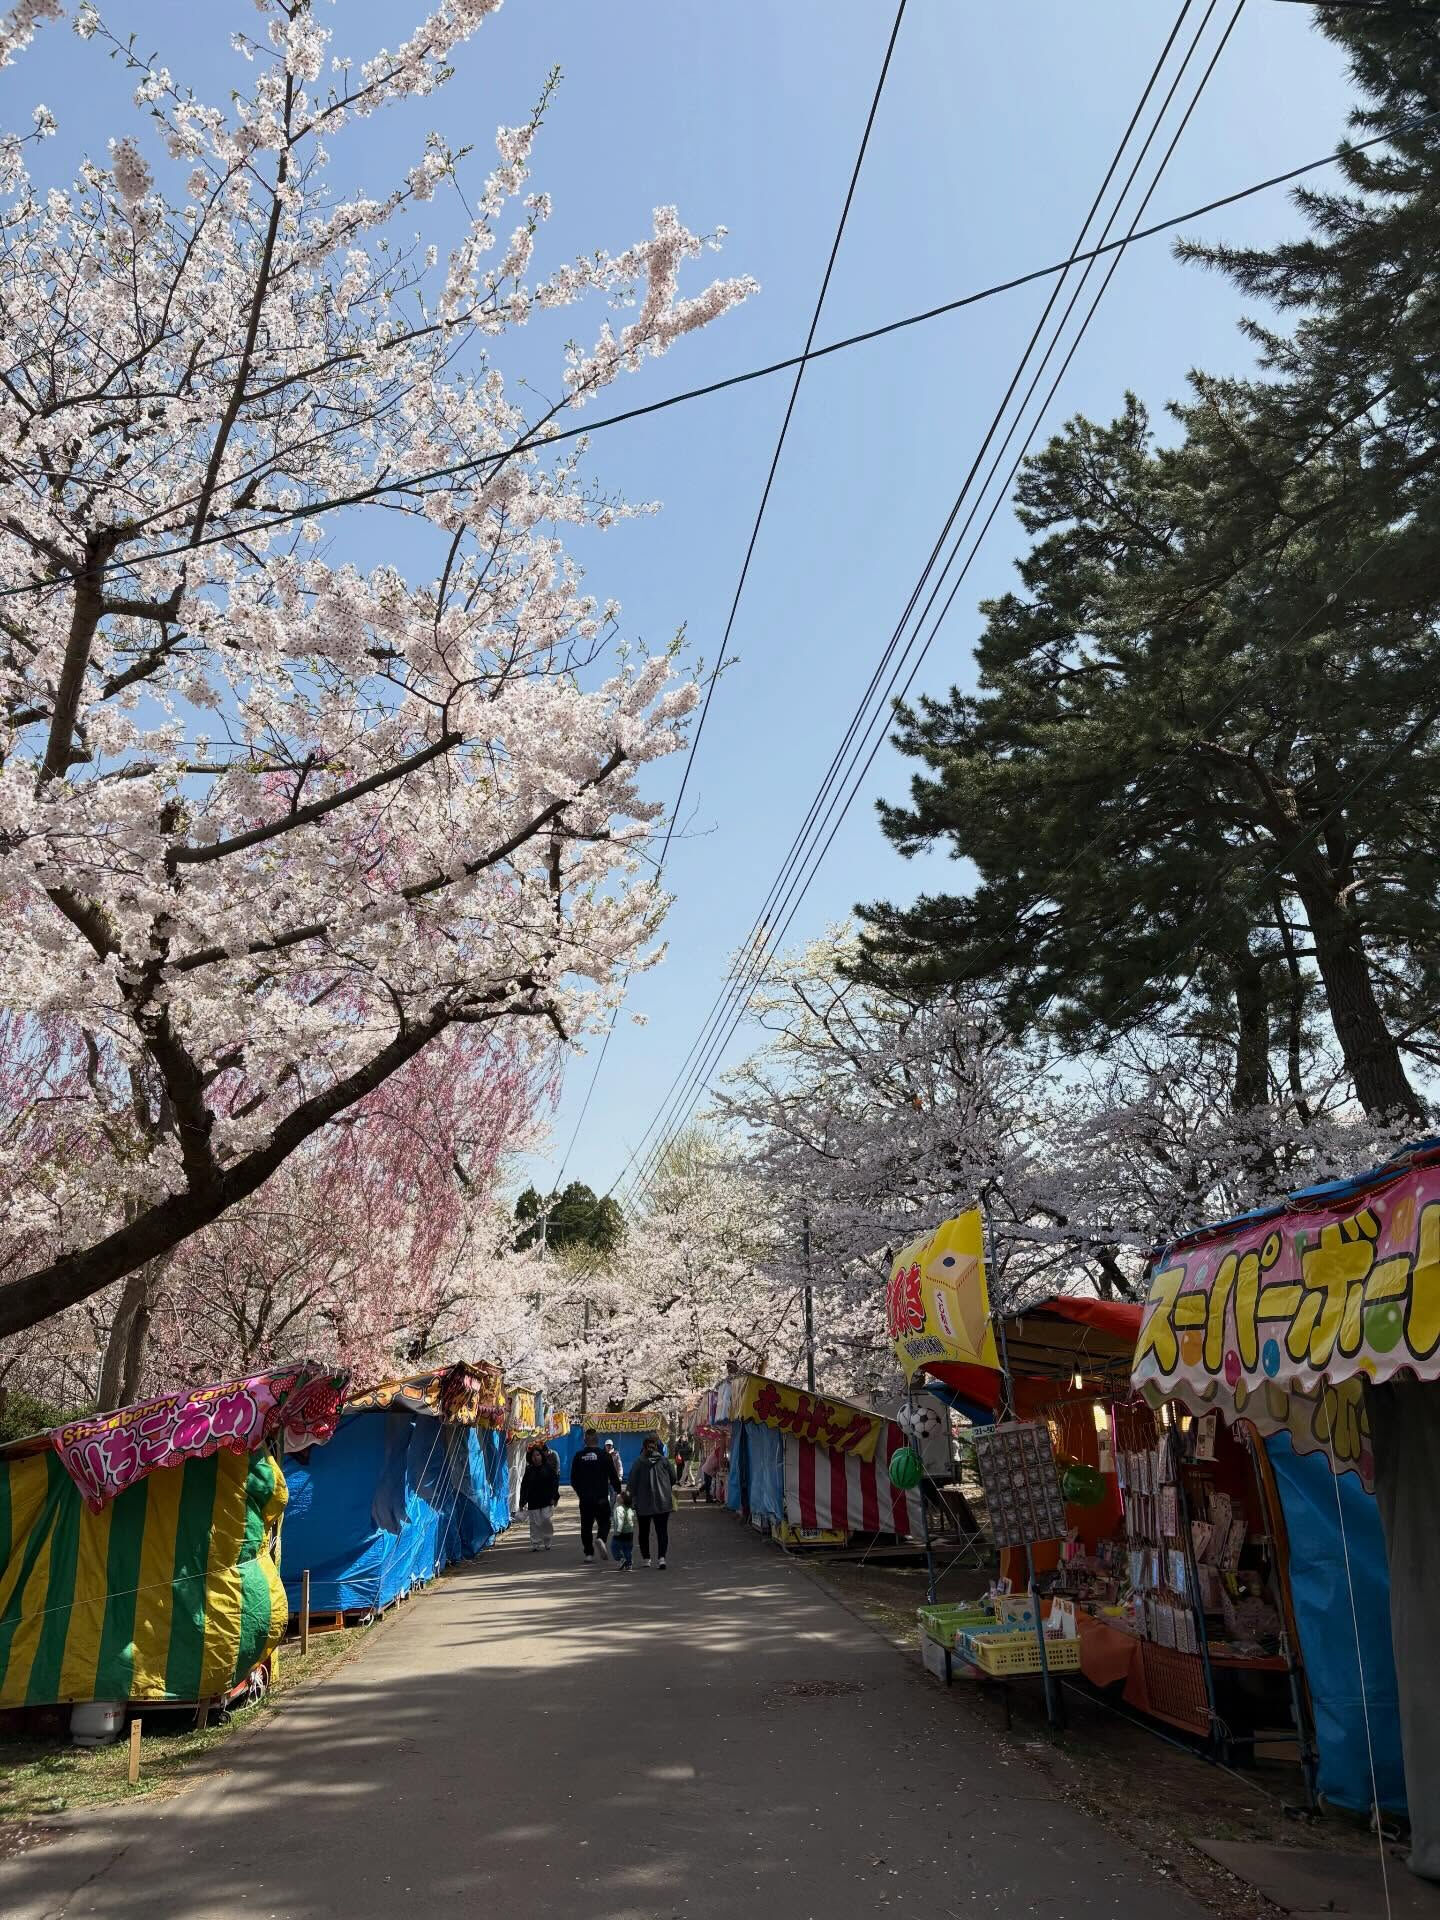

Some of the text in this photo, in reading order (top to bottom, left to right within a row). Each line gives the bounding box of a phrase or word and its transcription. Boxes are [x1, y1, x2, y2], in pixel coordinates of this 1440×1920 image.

[69, 1389, 257, 1497] いちごあめ
